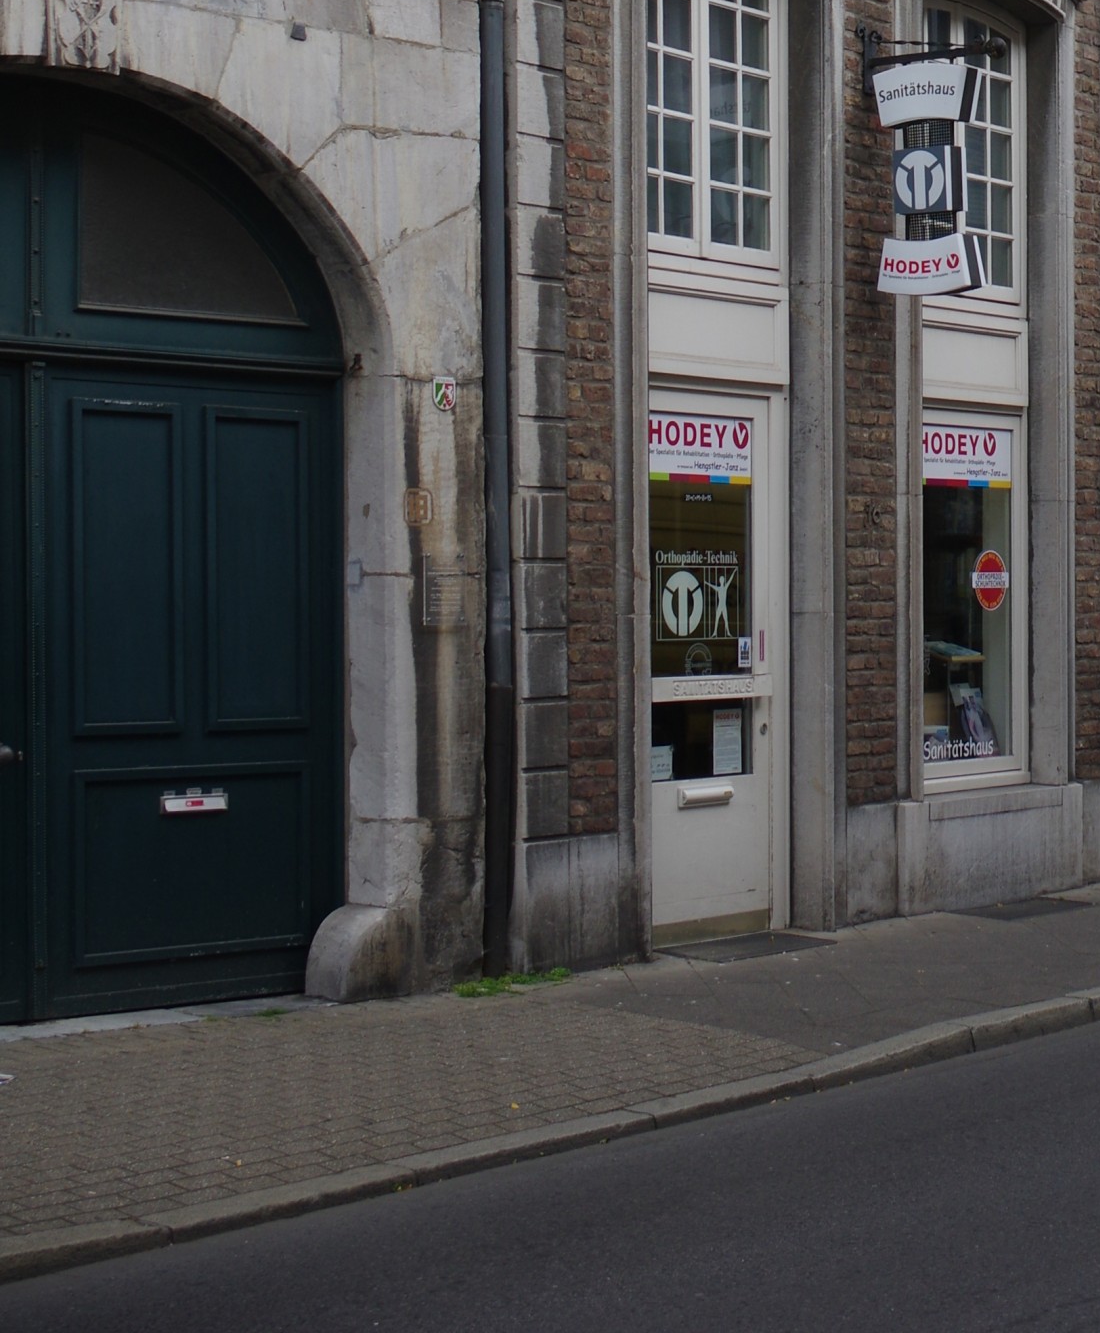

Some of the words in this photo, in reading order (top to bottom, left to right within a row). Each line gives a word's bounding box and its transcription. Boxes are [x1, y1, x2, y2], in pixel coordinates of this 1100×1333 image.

[878, 80, 956, 103] Sanitätshaus
[883, 257, 942, 274] HODEY
[648, 419, 728, 448] HODEY
[922, 431, 980, 456] HODEY
[693, 461, 739, 472] Hengstler-Janz
[655, 550, 739, 566] Orthopädie-Technik
[923, 735, 994, 760] Sanitätshaus
